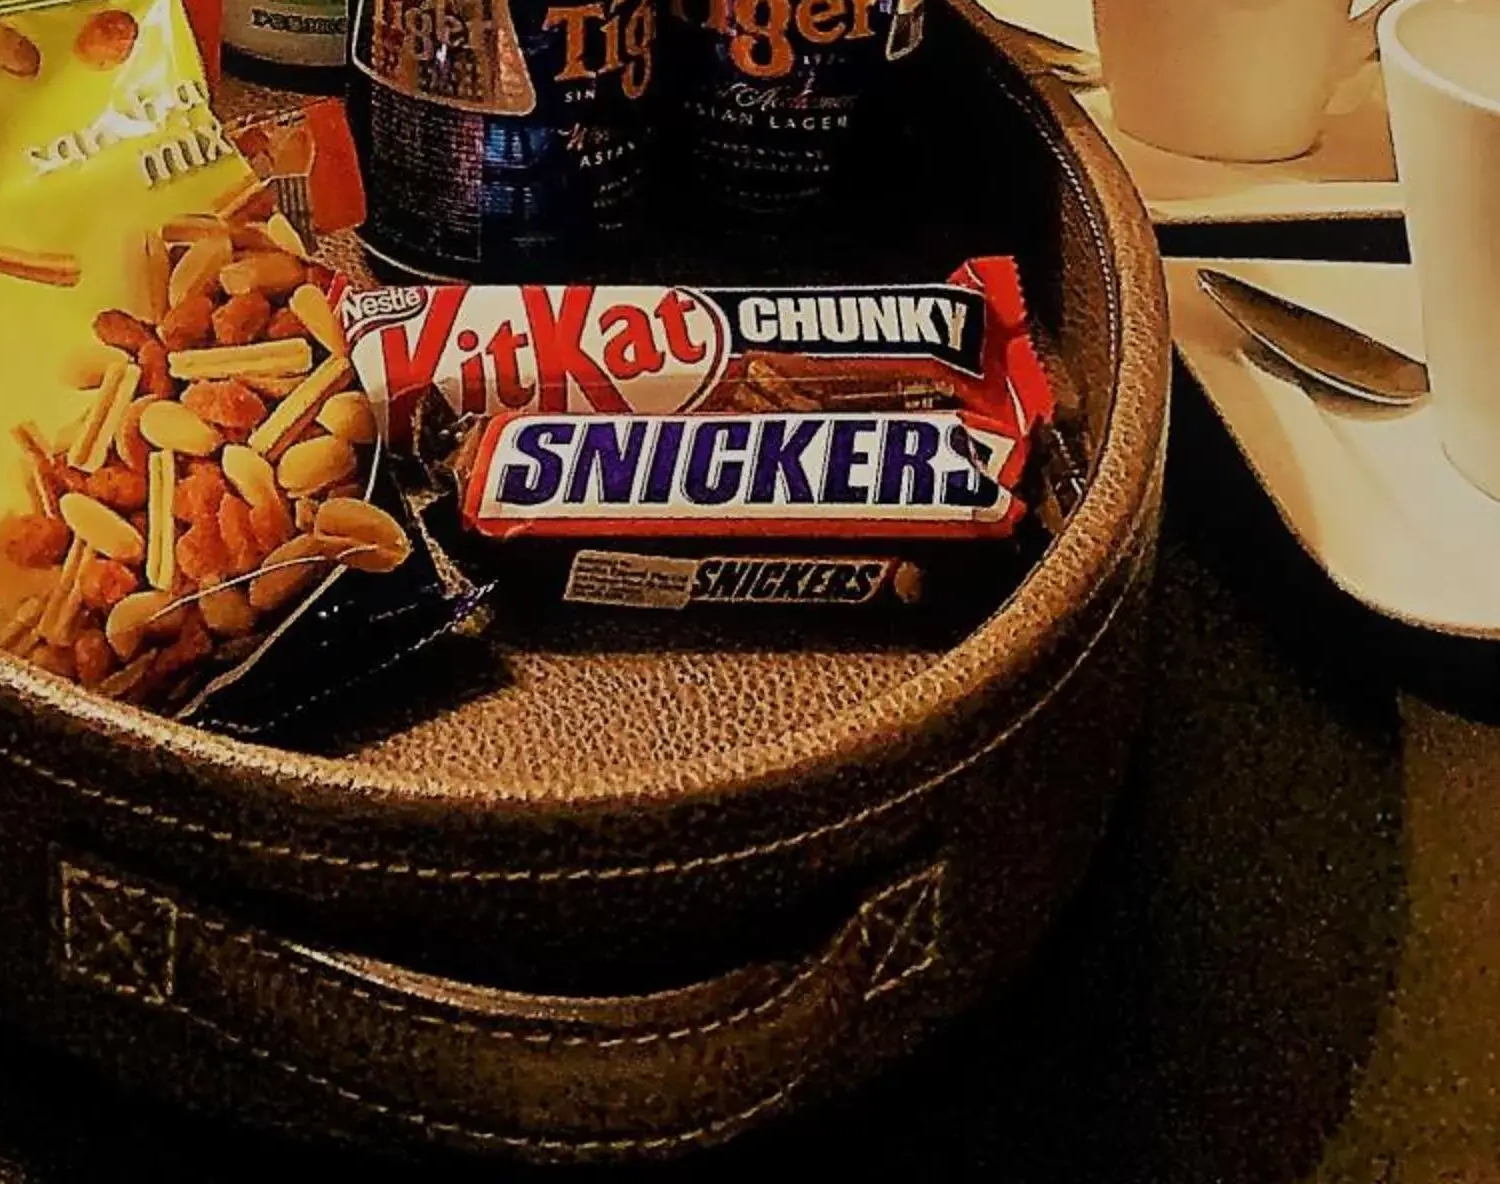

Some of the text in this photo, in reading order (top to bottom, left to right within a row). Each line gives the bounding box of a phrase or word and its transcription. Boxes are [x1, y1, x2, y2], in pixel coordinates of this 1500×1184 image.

[380, 283, 708, 421] KitKat
[738, 296, 968, 351] CHUNKY
[497, 418, 1000, 508] SNICKERS
[696, 561, 880, 602] SNICKERS
